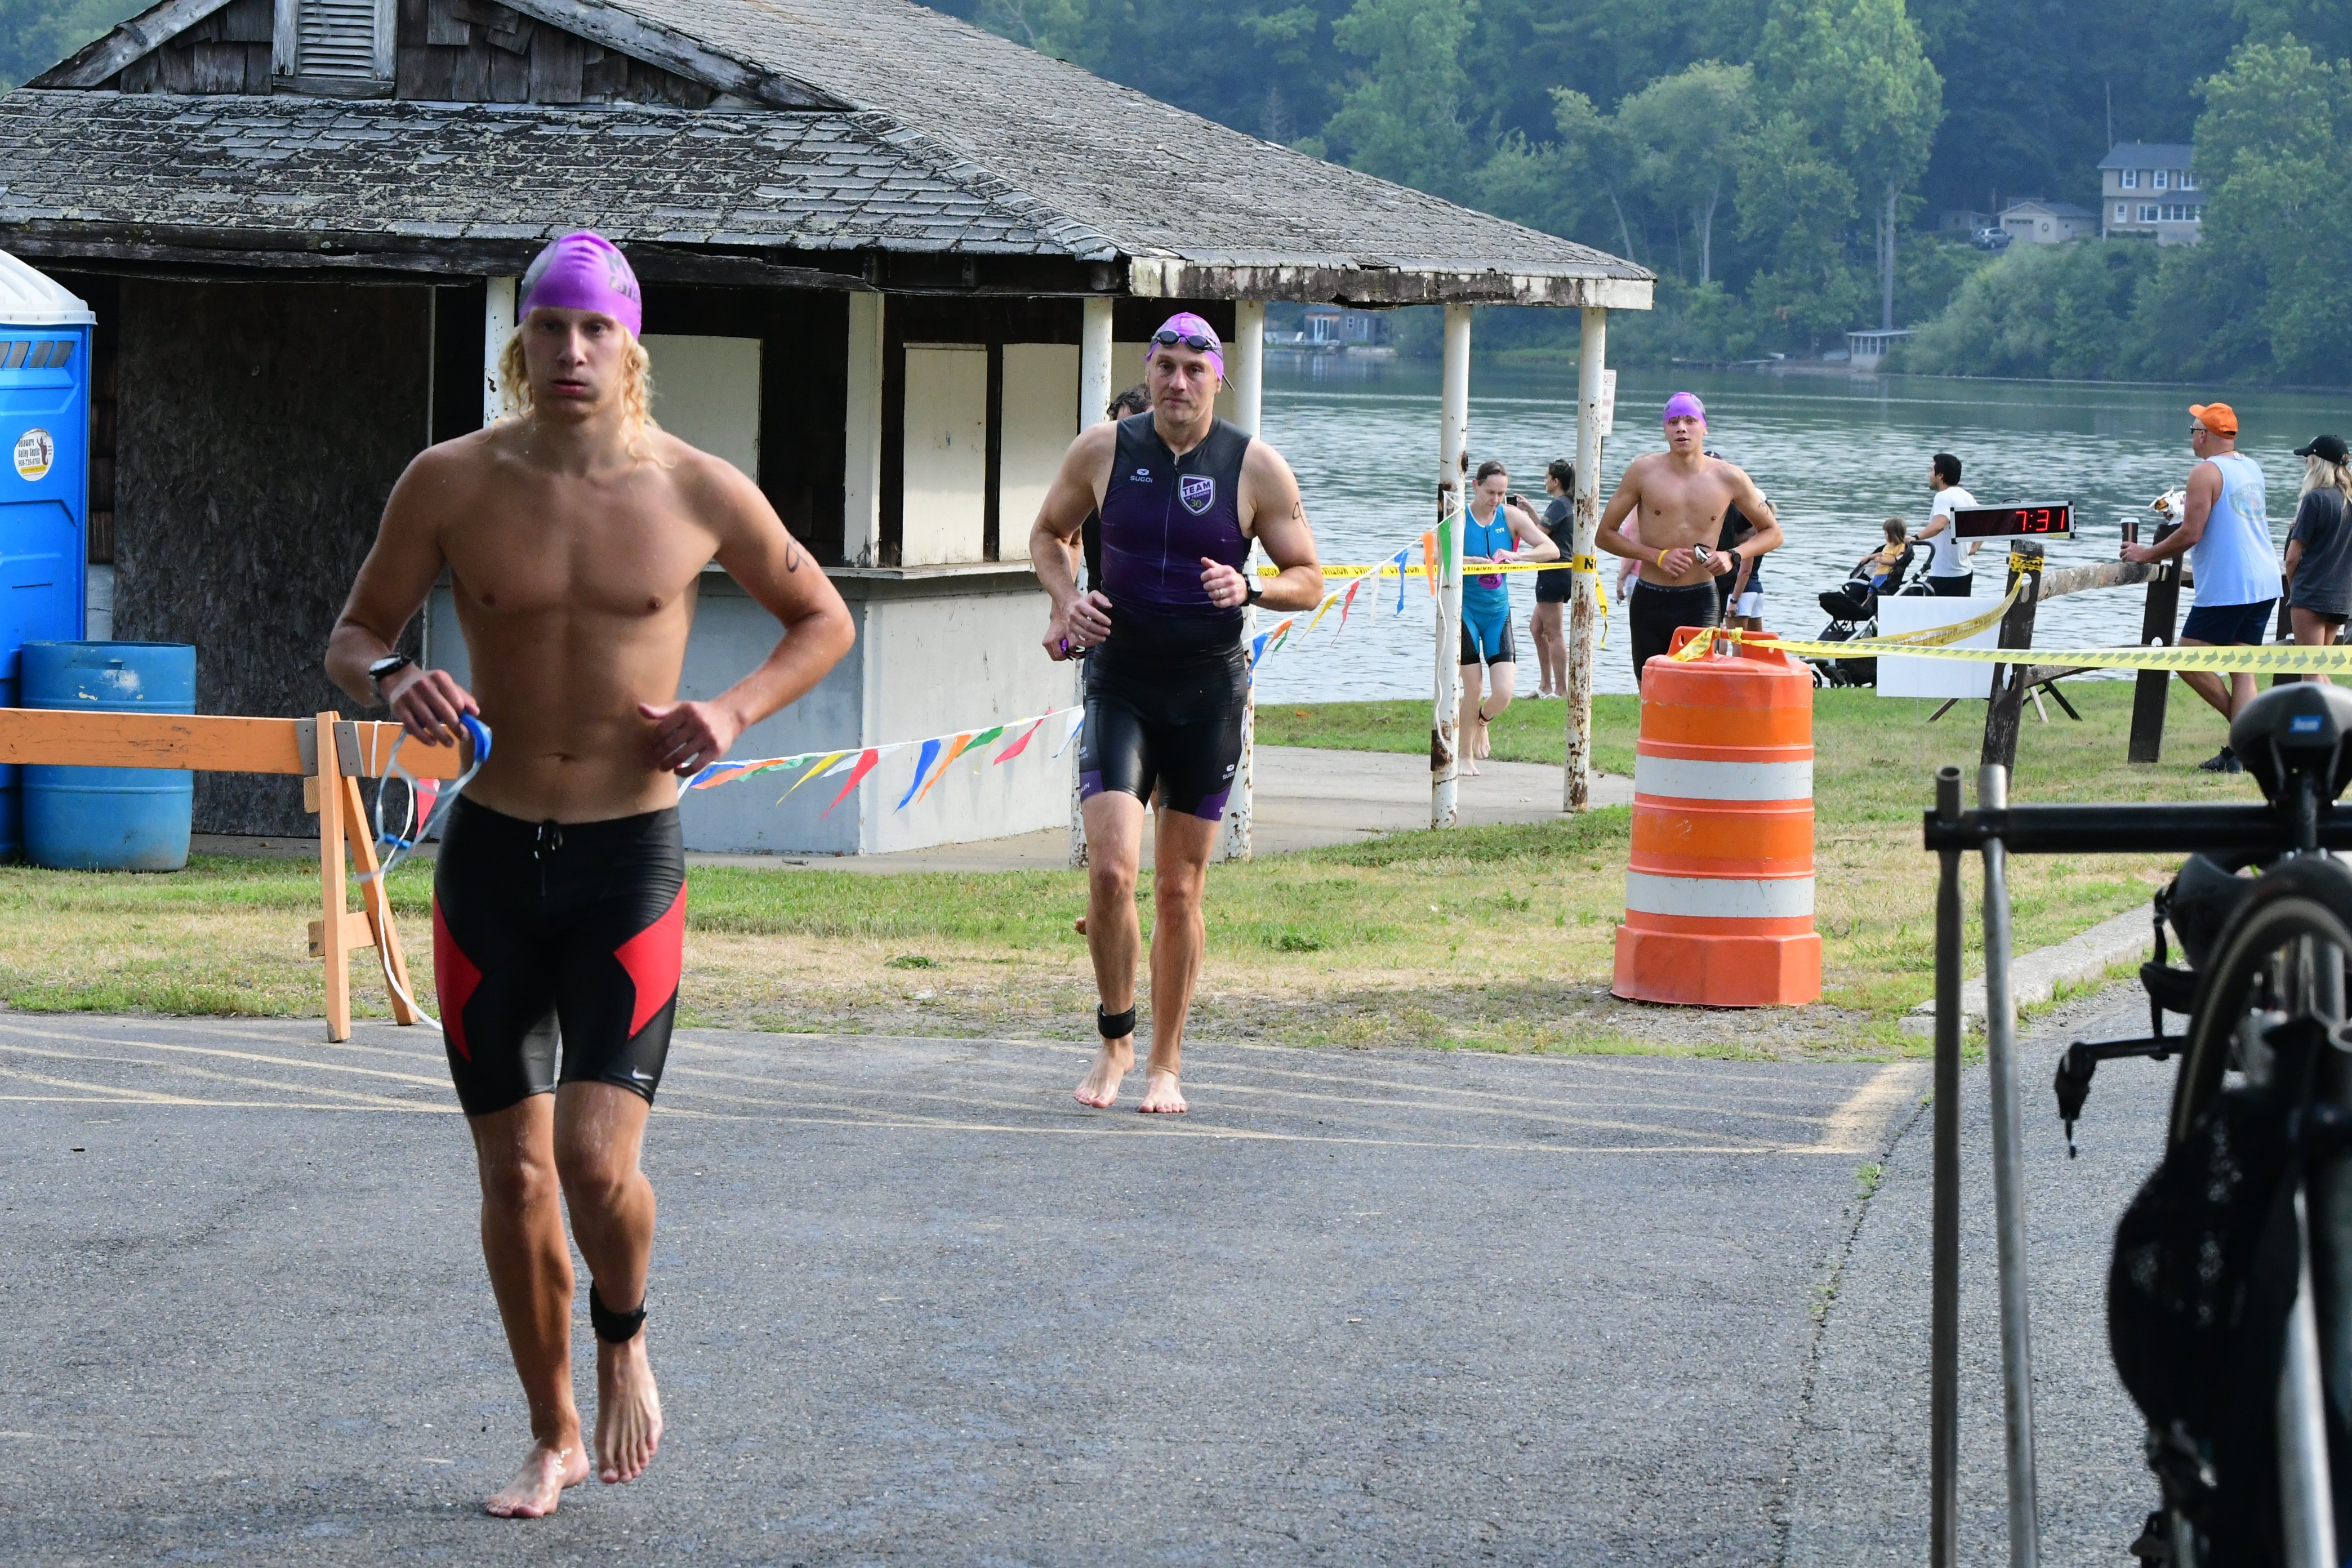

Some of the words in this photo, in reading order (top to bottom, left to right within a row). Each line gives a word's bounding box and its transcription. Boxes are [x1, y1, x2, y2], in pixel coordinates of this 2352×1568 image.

[19, 449, 28, 458] Valley
[29, 448, 39, 457] Septic
[1183, 481, 1210, 496] TEAM
[2015, 509, 2065, 532] 7:31
